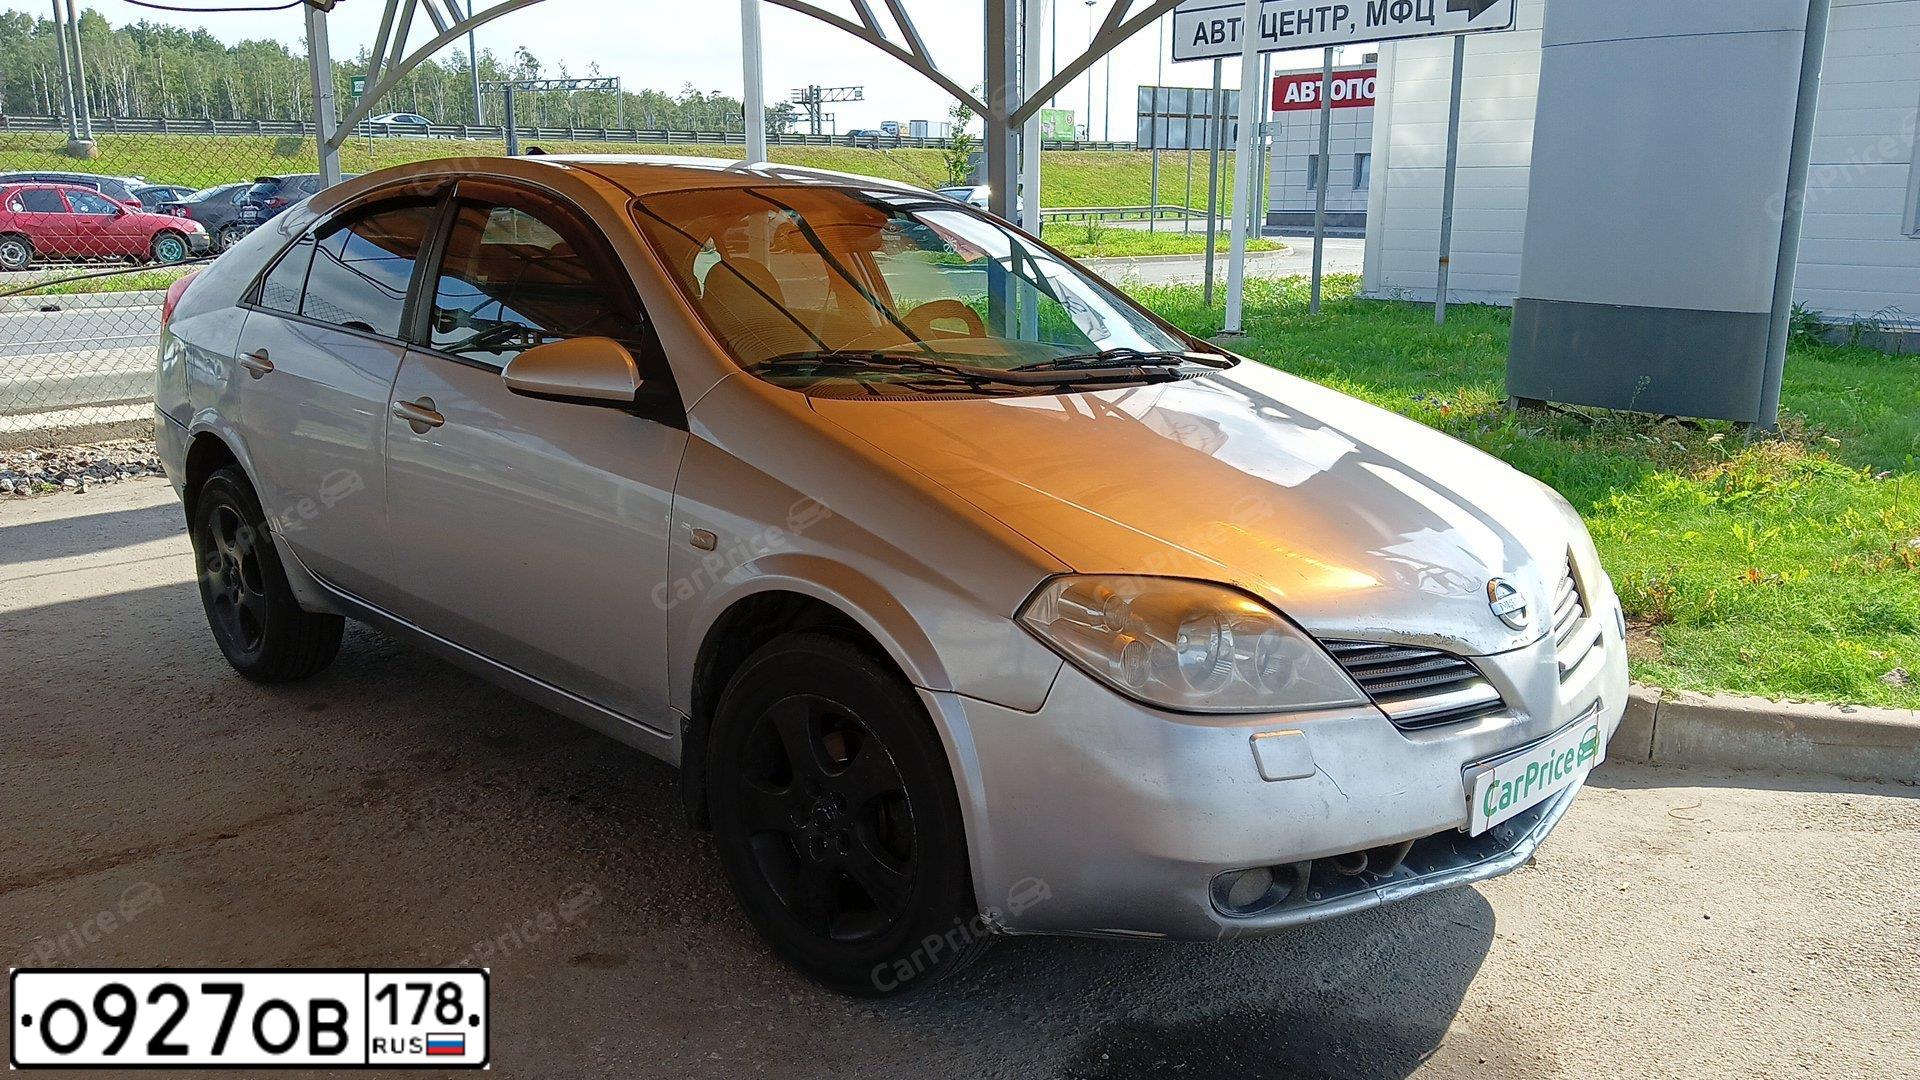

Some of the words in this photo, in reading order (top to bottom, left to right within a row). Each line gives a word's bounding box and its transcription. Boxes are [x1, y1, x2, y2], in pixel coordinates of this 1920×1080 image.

[1193, 3, 1355, 46] АВТЦЕНТР,
[1366, 0, 1435, 27] МФЦ
[1483, 748, 1575, 817] CarPrice
